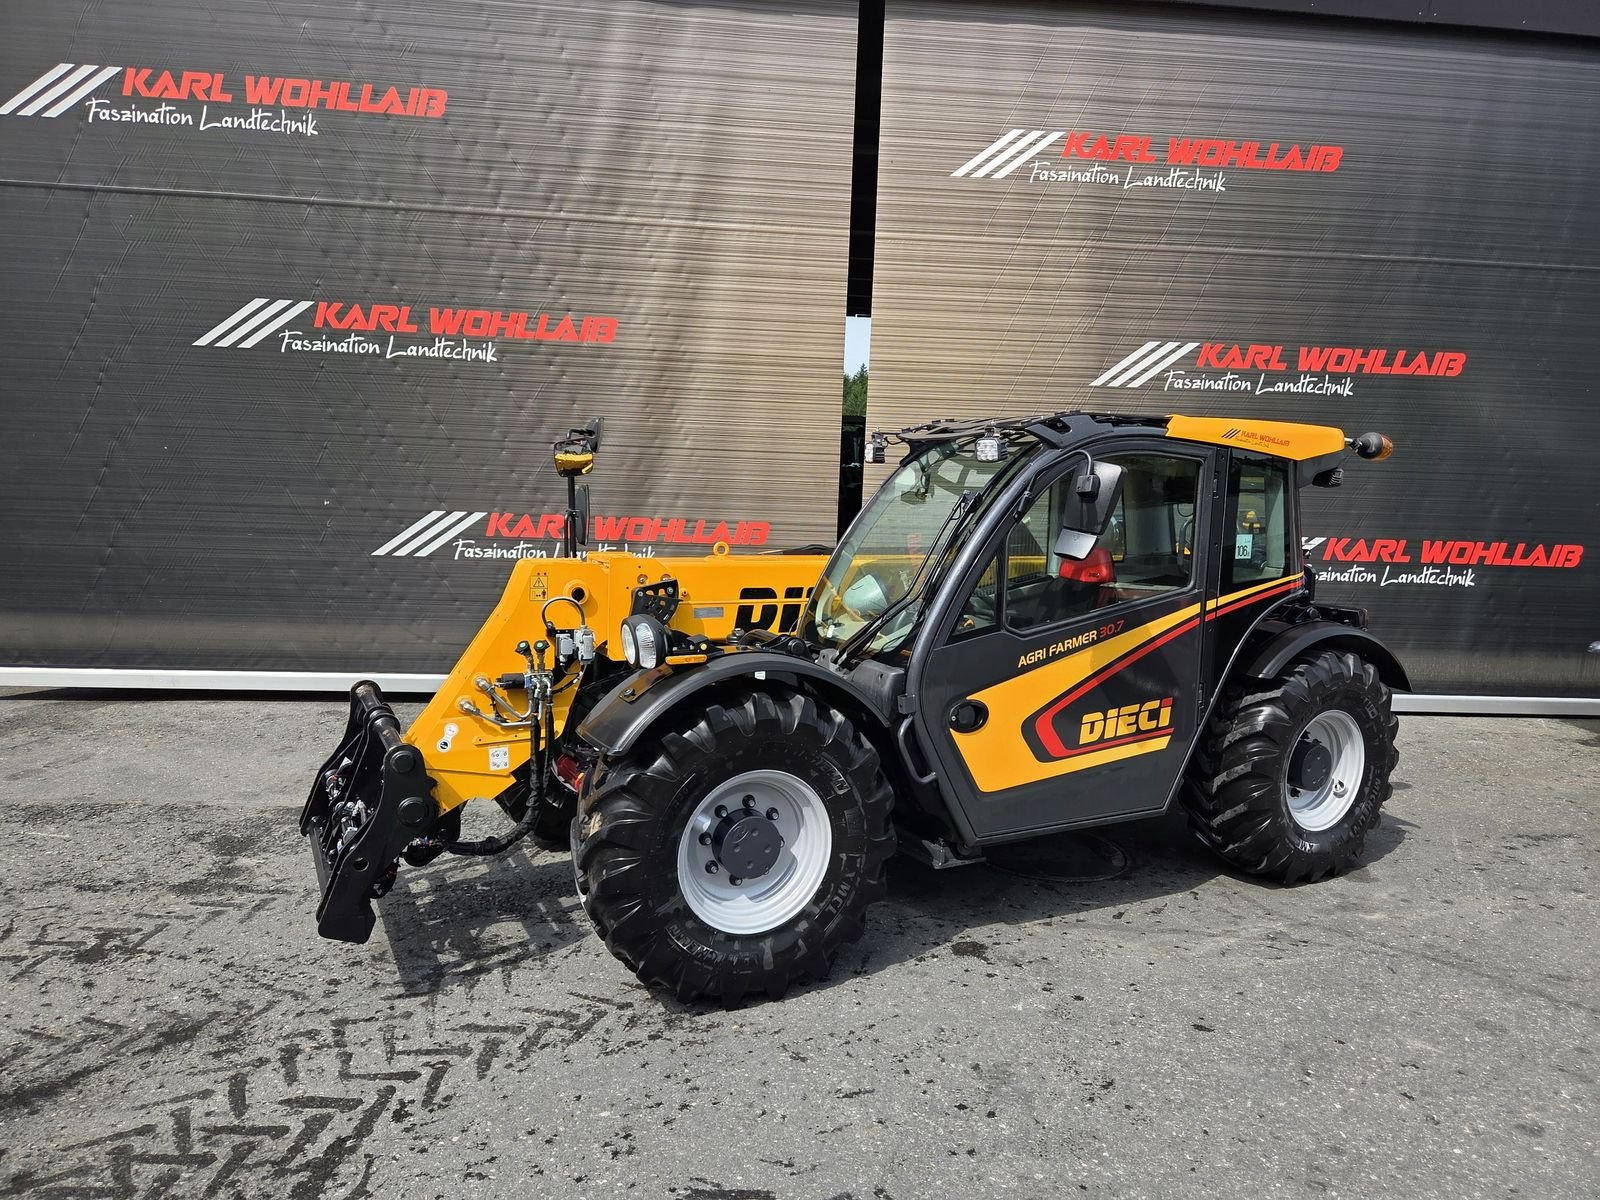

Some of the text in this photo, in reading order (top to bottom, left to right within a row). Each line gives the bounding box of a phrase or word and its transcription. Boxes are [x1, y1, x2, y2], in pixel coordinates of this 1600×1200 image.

[123, 69, 231, 102] KARL
[86, 97, 319, 137] Faszination Landtechnik
[1062, 132, 1157, 164] KARL
[1029, 160, 1226, 193] Faszination Landtechnik
[313, 302, 418, 333] KARL
[278, 329, 498, 363] Faszination Landtechnik
[1196, 343, 1288, 372] KARL
[1164, 369, 1354, 397] Faszination Landtechnik
[1241, 430, 1258, 440] KARL
[486, 512, 570, 539] KAR
[452, 539, 547, 560] Faszination
[1322, 537, 1411, 563] KARL
[1312, 564, 1475, 588] zination Landtechnik
[735, 586, 815, 634] DI
[1017, 619, 1125, 668] AGRI FARMER 30.7
